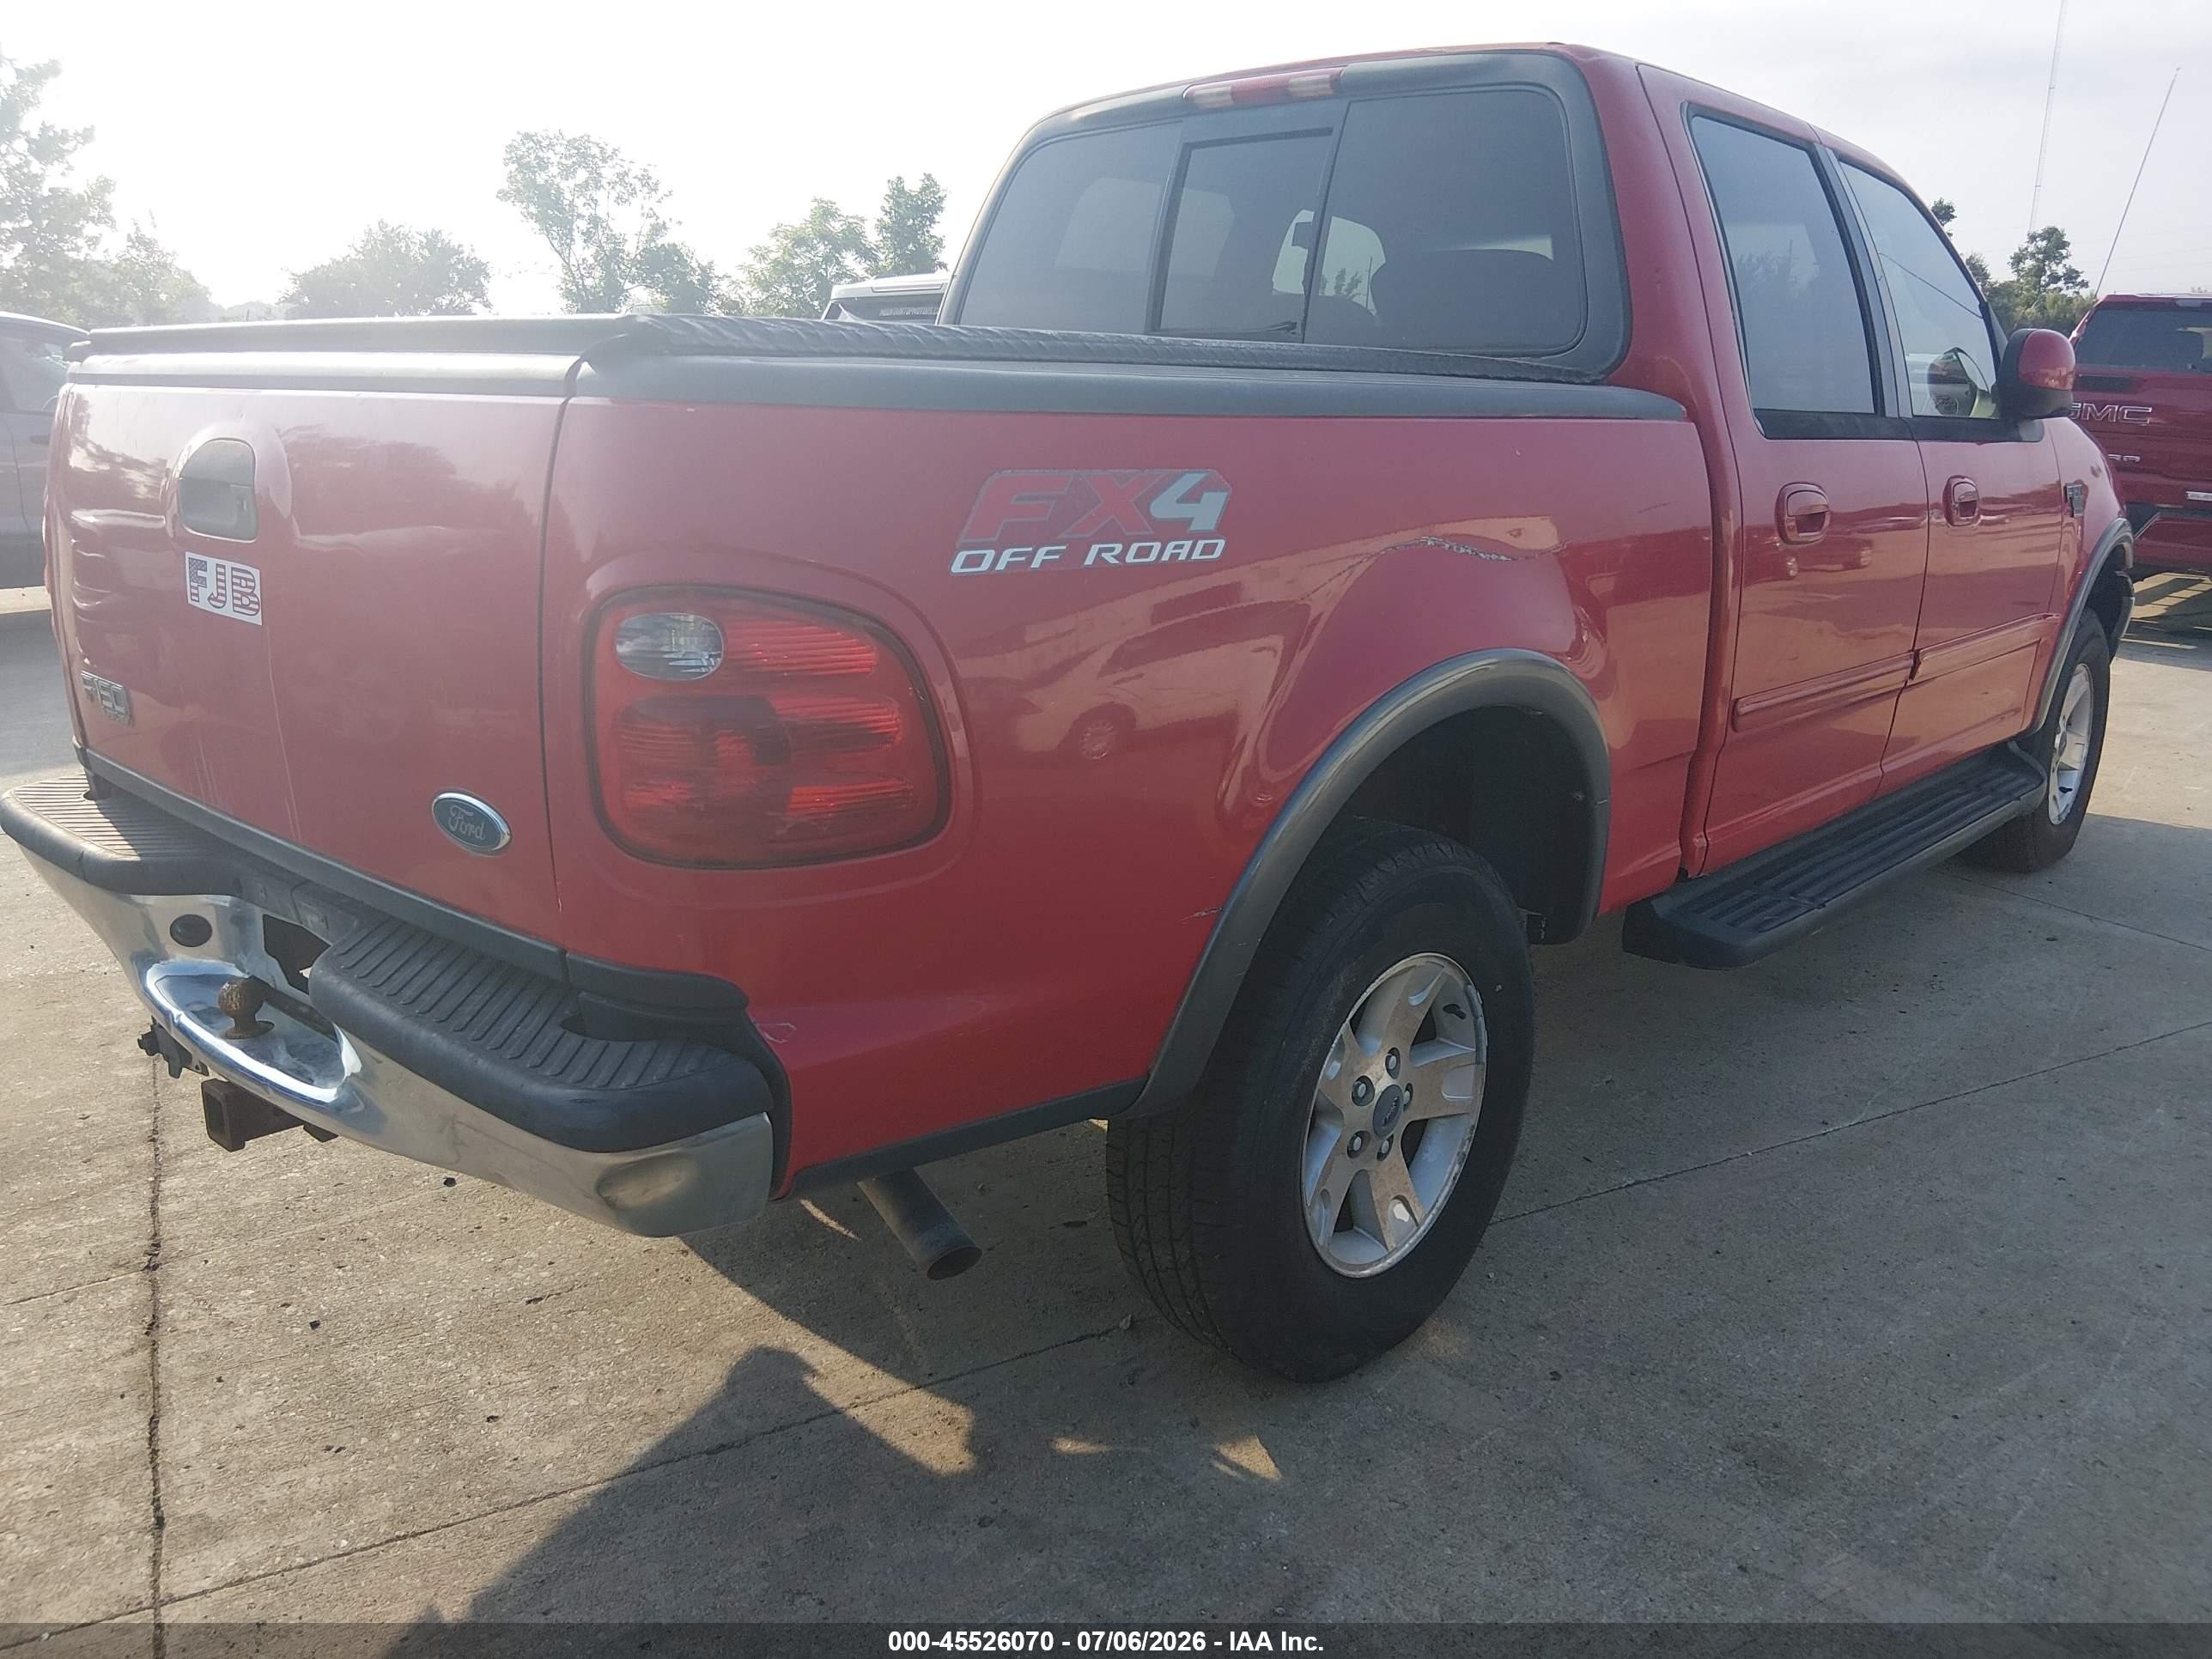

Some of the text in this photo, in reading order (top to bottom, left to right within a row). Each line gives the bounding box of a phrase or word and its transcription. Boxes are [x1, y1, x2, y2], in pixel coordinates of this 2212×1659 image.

[957, 470, 1231, 544] FX4
[950, 538, 1226, 574] OFF ROAD
[188, 556, 260, 617] FJB
[447, 805, 486, 840] Ford
